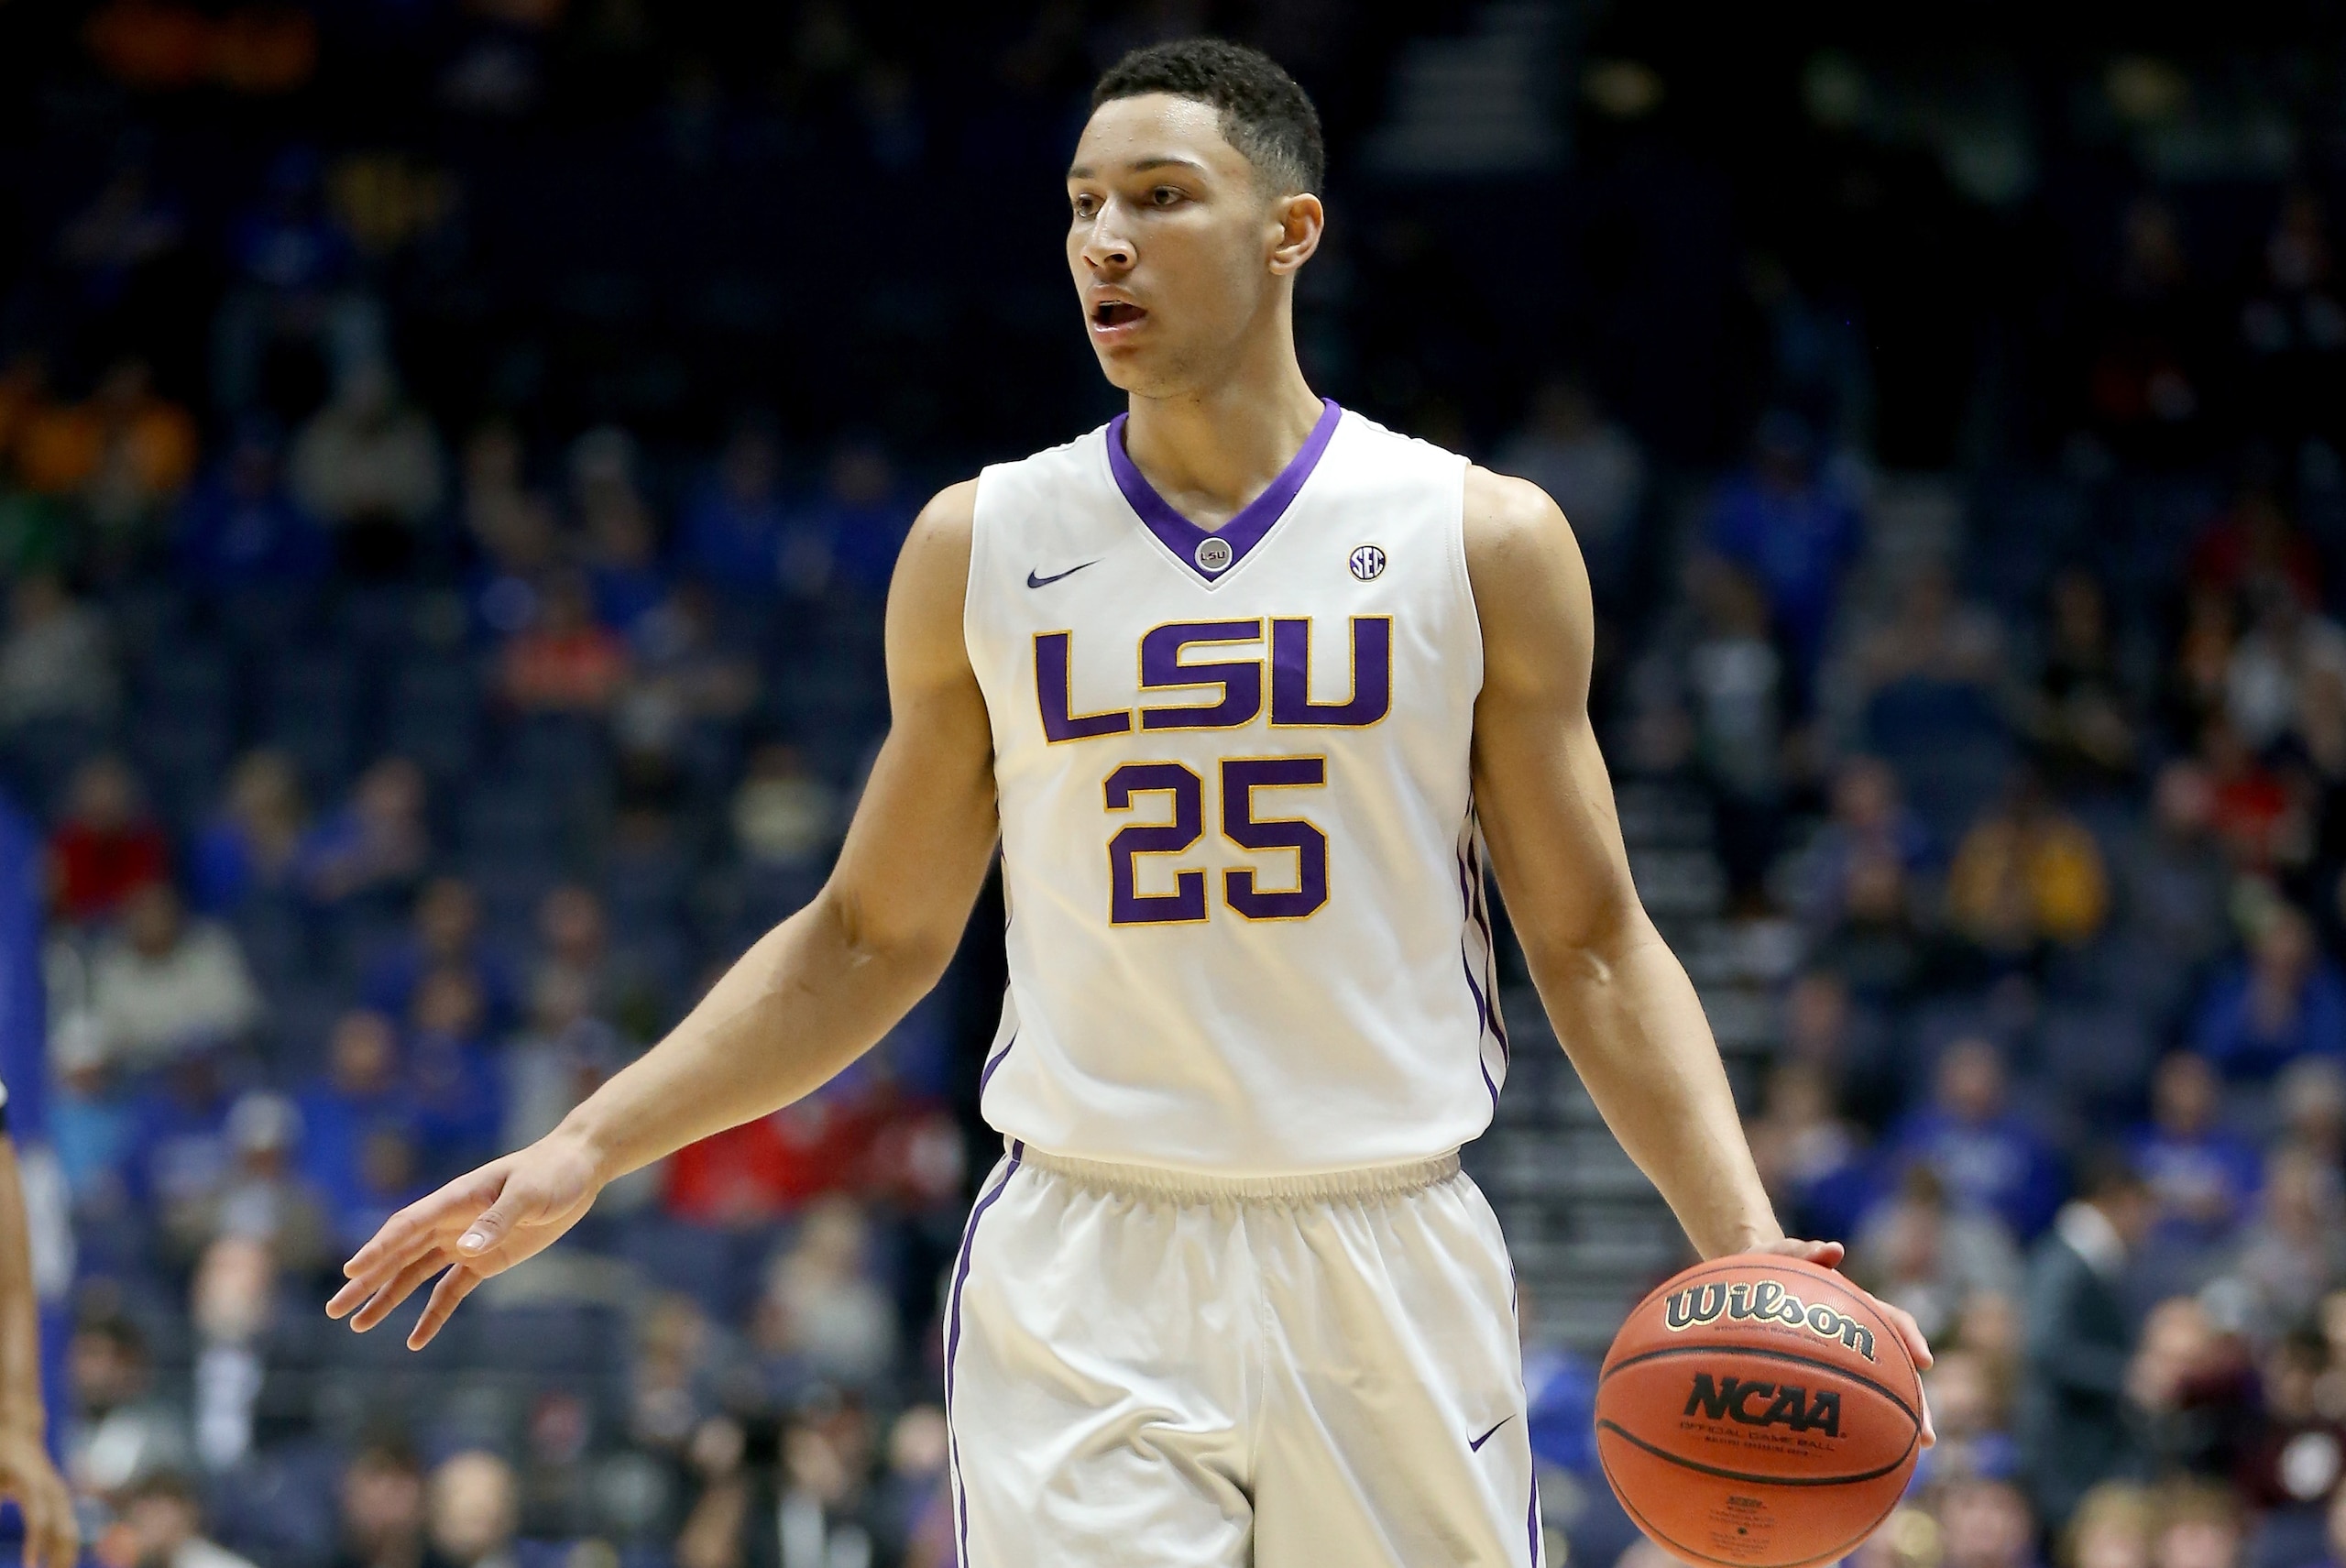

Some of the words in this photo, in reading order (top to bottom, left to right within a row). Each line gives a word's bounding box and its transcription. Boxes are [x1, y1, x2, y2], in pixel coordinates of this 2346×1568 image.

[1200, 550, 1226, 562] LSU
[1350, 546, 1385, 579] SEC
[1033, 615, 1393, 746] LSU
[1102, 754, 1331, 927] 25
[1664, 1280, 1875, 1363] Wilson
[1680, 1421, 1740, 1437] OFFICIAL
[1749, 1431, 1792, 1445] GAME
[1796, 1439, 1836, 1452] BALL
[1683, 1373, 1840, 1437] NCAA
